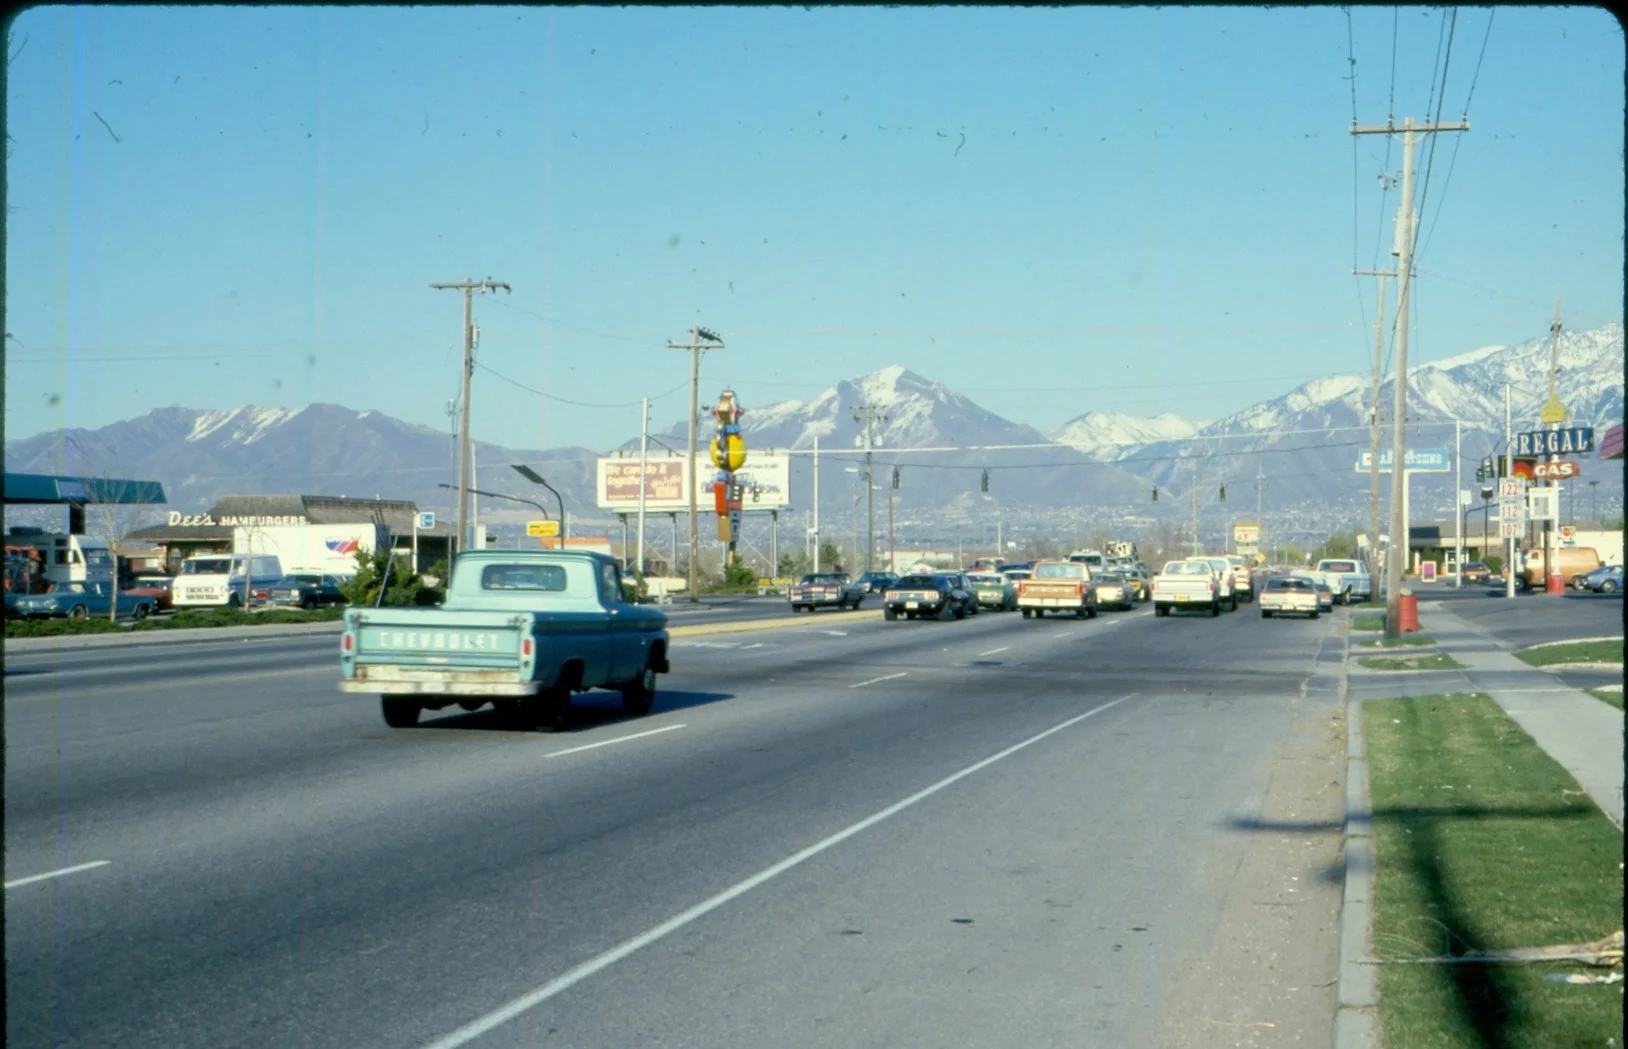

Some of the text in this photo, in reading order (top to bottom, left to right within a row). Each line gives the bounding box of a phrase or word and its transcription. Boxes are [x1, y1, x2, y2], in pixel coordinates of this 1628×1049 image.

[1519, 429, 1588, 455] REGAL
[1534, 463, 1573, 476] GAS
[607, 475, 647, 488] togethe
[222, 515, 307, 526] HAMBURGERS
[379, 632, 499, 649] CHEVROLET
